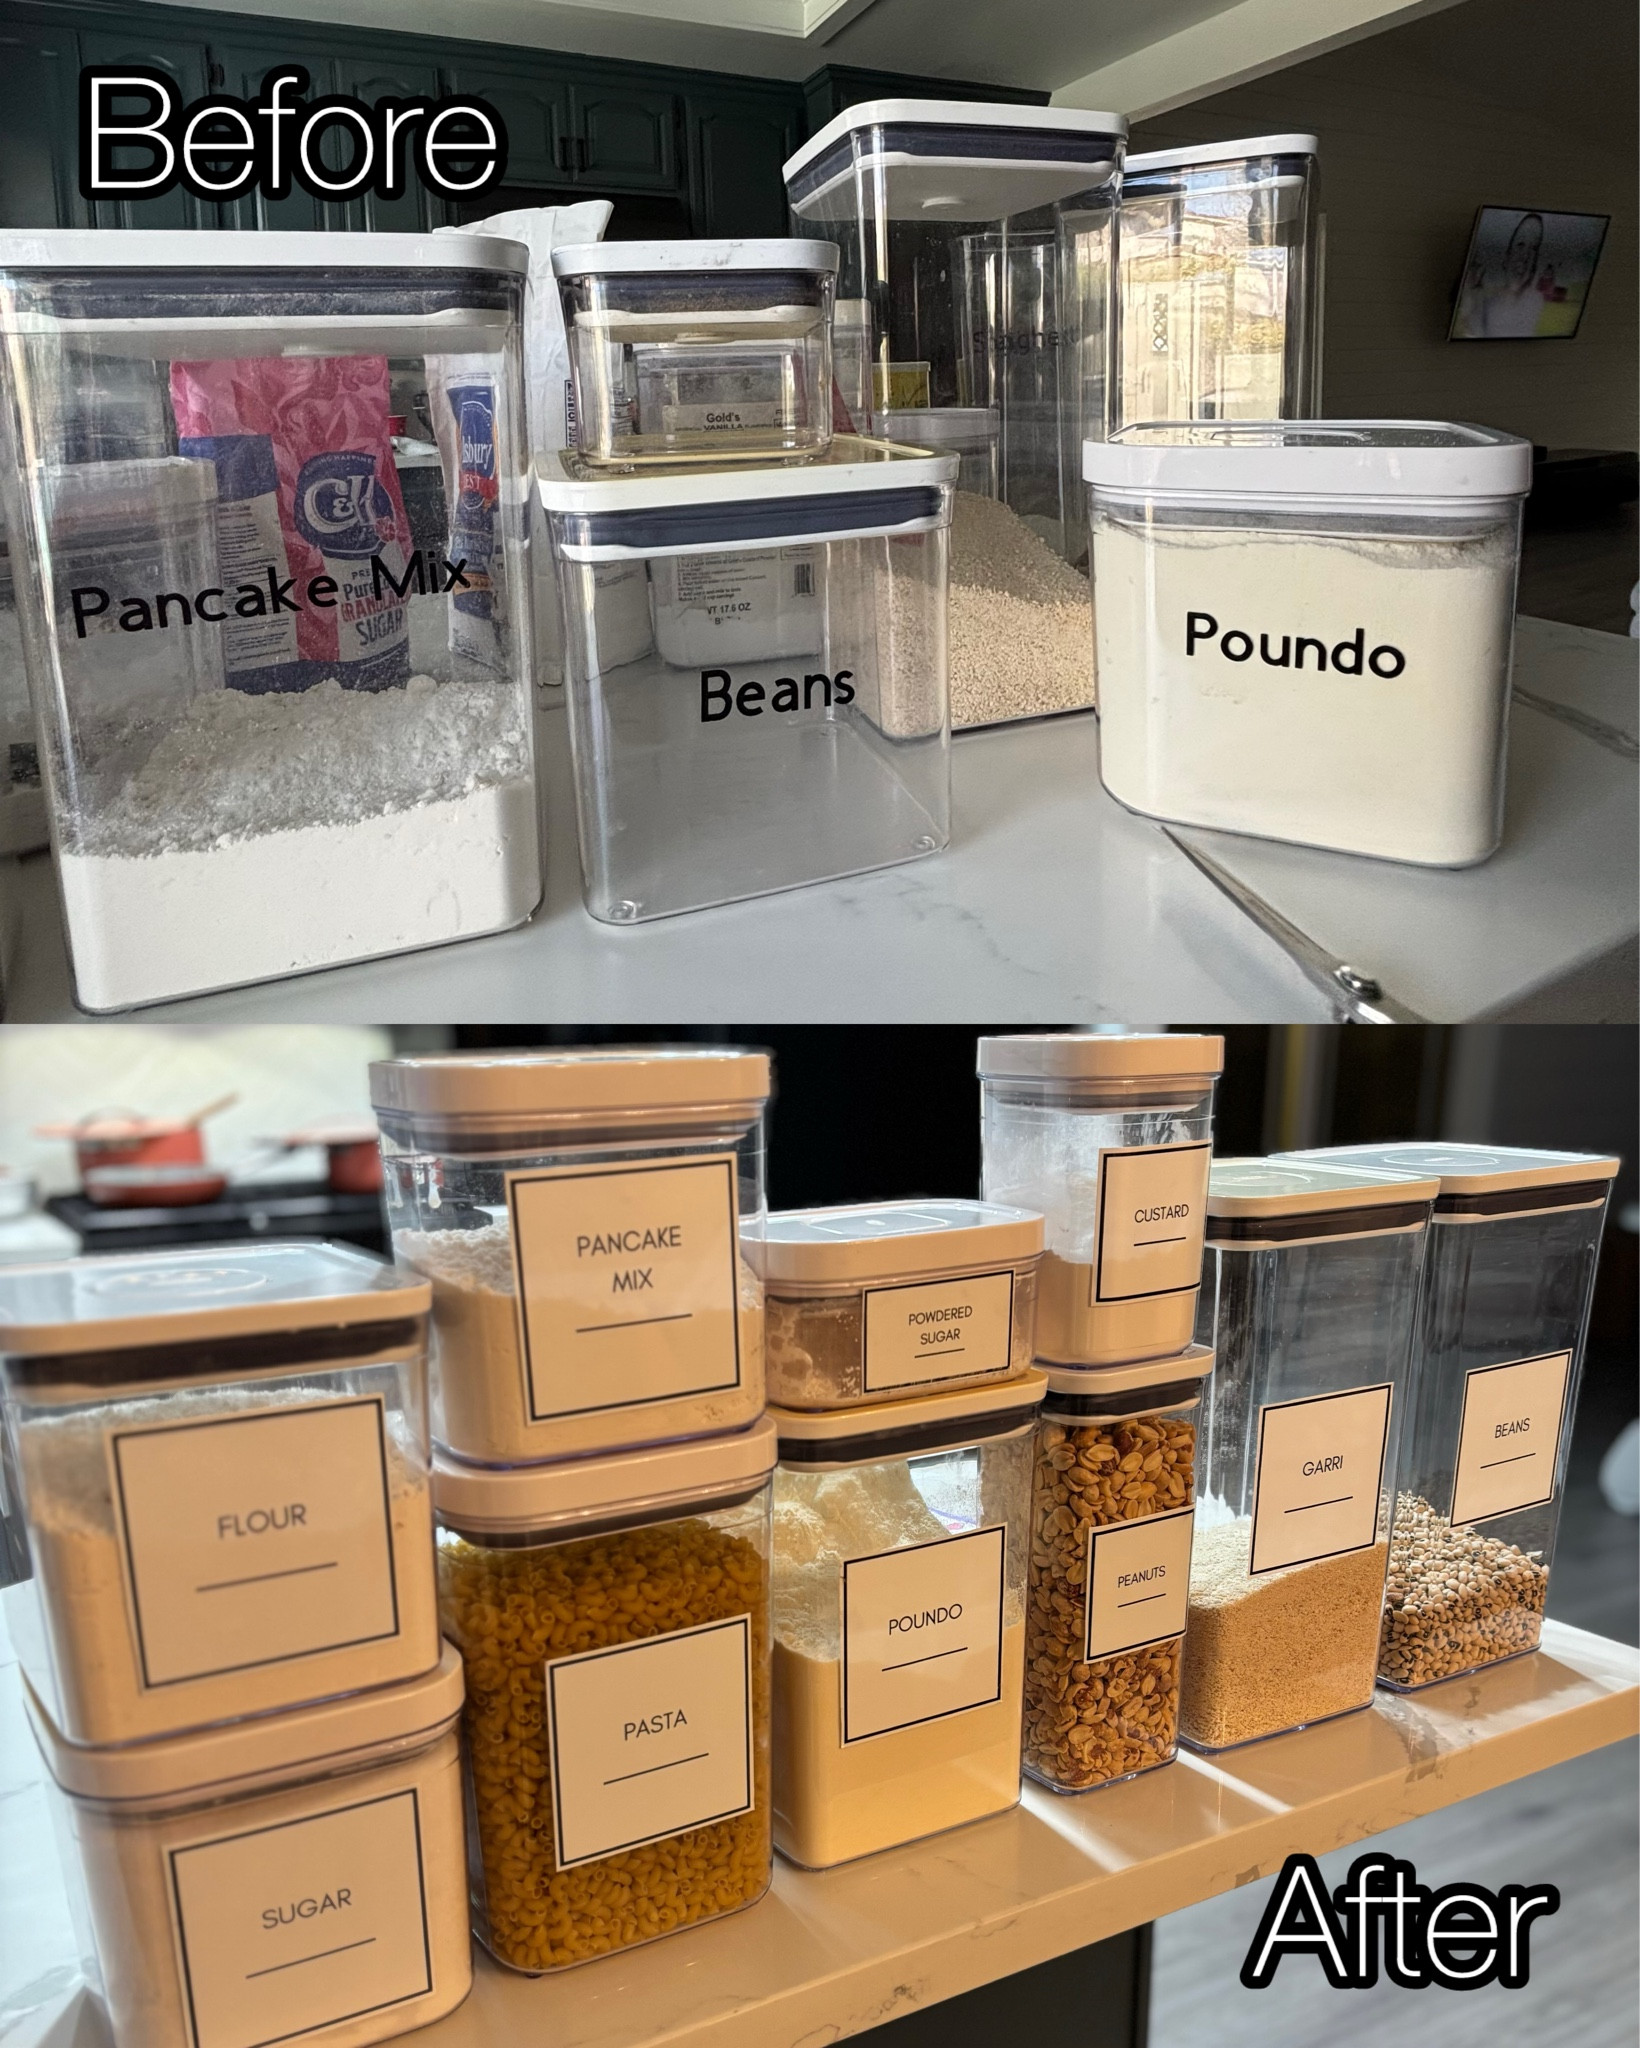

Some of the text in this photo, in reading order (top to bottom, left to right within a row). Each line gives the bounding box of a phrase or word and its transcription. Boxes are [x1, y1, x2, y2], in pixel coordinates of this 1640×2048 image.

[704, 423, 743, 431] VANILLA
[706, 412, 741, 423] Gold's
[71, 566, 339, 638] Pancake
[370, 550, 471, 601] Mix
[738, 602, 751, 612] OZ
[355, 608, 403, 646] SUGAR
[1186, 612, 1406, 679] Poundo
[701, 670, 855, 723] Beans
[1134, 1203, 1190, 1225] CUSTARD
[576, 1225, 682, 1257] PANCAKE
[612, 1268, 654, 1294] MIX
[908, 1304, 973, 1327] POWDERED
[920, 1326, 961, 1345] SUGAR
[1494, 1416, 1531, 1440] BEANS
[1302, 1454, 1344, 1478] GARRI
[217, 1503, 307, 1541] FLOUR
[1117, 1564, 1167, 1588] PEANUTS
[887, 1602, 963, 1636] POUNDO
[623, 1709, 688, 1742] PASTA
[261, 1888, 352, 1930] SUGAR
